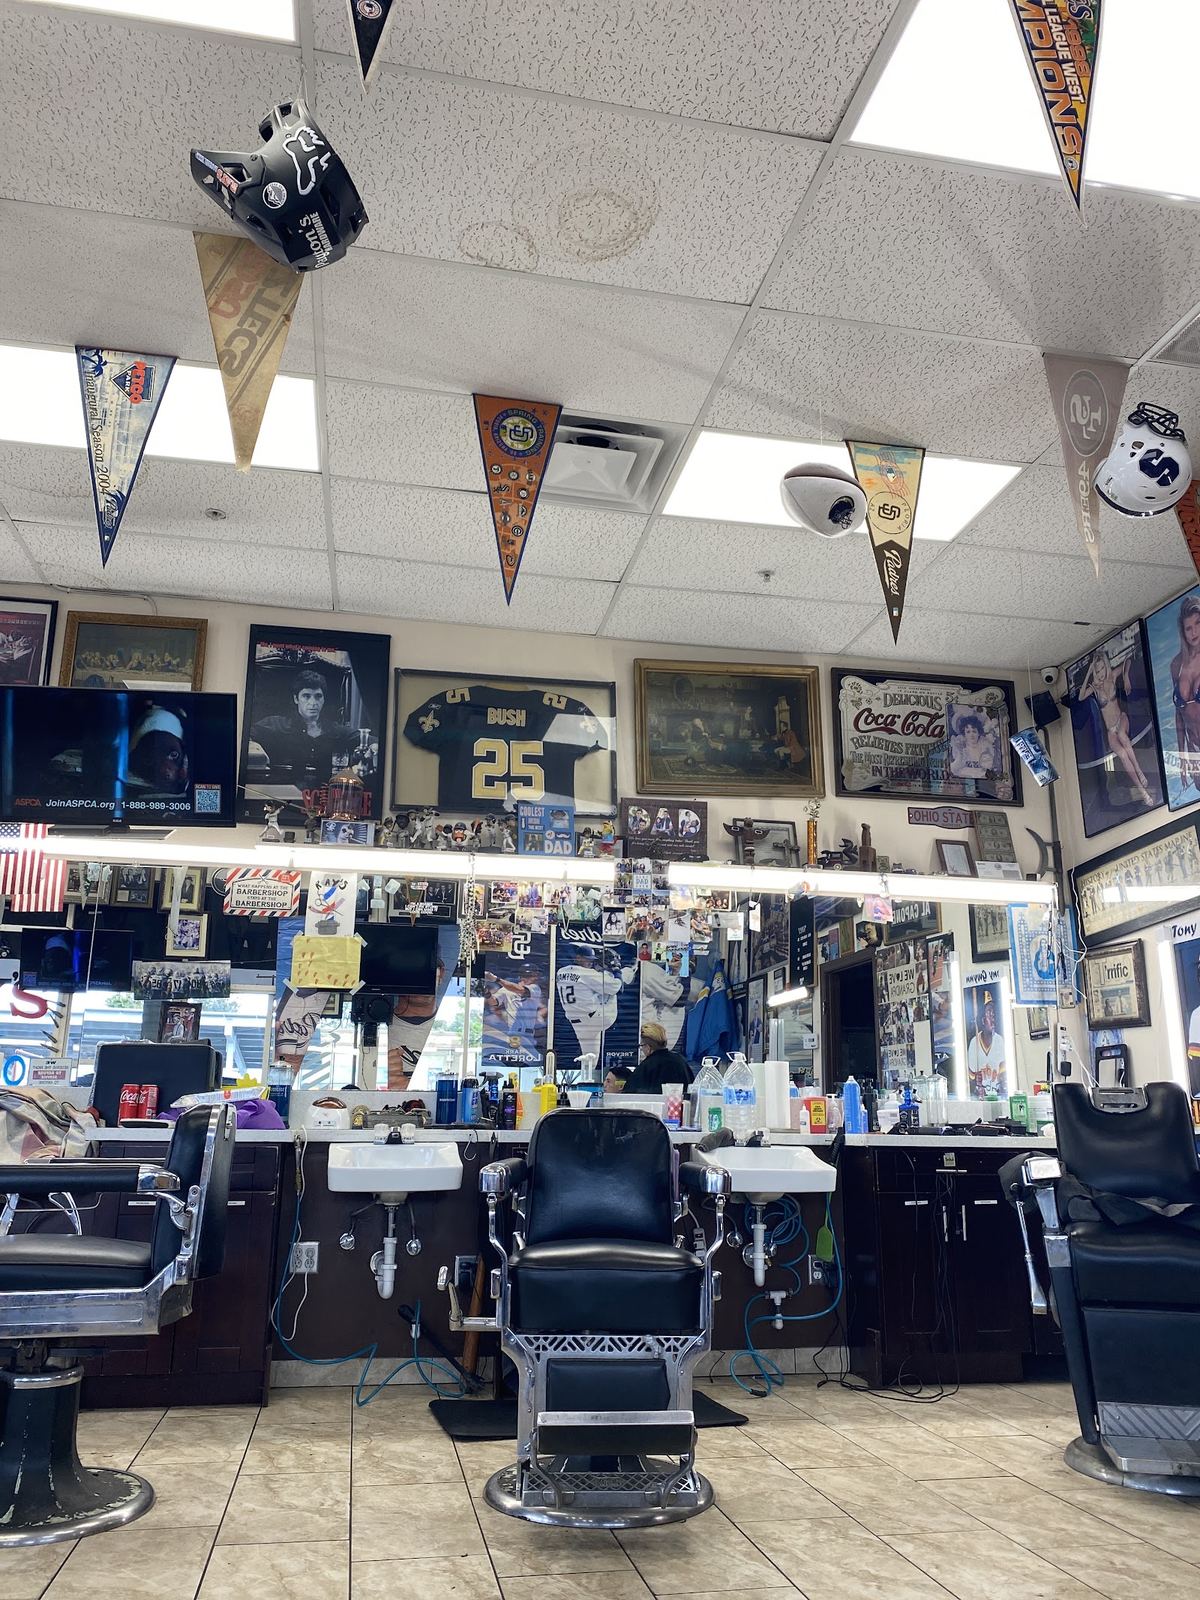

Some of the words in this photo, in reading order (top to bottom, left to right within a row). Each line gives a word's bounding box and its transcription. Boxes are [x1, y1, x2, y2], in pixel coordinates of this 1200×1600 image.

[1046, 9, 1071, 59] LEAGUE
[1061, 62, 1085, 103] WEST
[1064, 16, 1090, 77] 1998
[124, 370, 133, 392] PARK
[130, 360, 147, 404] PETCO
[84, 370, 101, 421] Inaugural
[92, 423, 104, 463] Season
[96, 466, 109, 495] 2004
[883, 549, 903, 596] Padres
[883, 693, 943, 711] DELICIOUS
[487, 706, 527, 727] BUSH
[853, 707, 946, 739] Coca-Cola
[850, 735, 905, 754] RELIEVES
[471, 737, 545, 801] 25
[46, 799, 115, 811] JoinASPCA.org
[121, 800, 191, 811] 1-888-989-3006
[520, 806, 545, 817] COOLEST
[914, 810, 940, 823] OHIO
[943, 811, 975, 826] STATE
[544, 839, 573, 855] DAD
[236, 888, 289, 897] BARBERSHOP
[235, 900, 288, 909] BARBERSHOP
[1171, 922, 1198, 939] Tony
